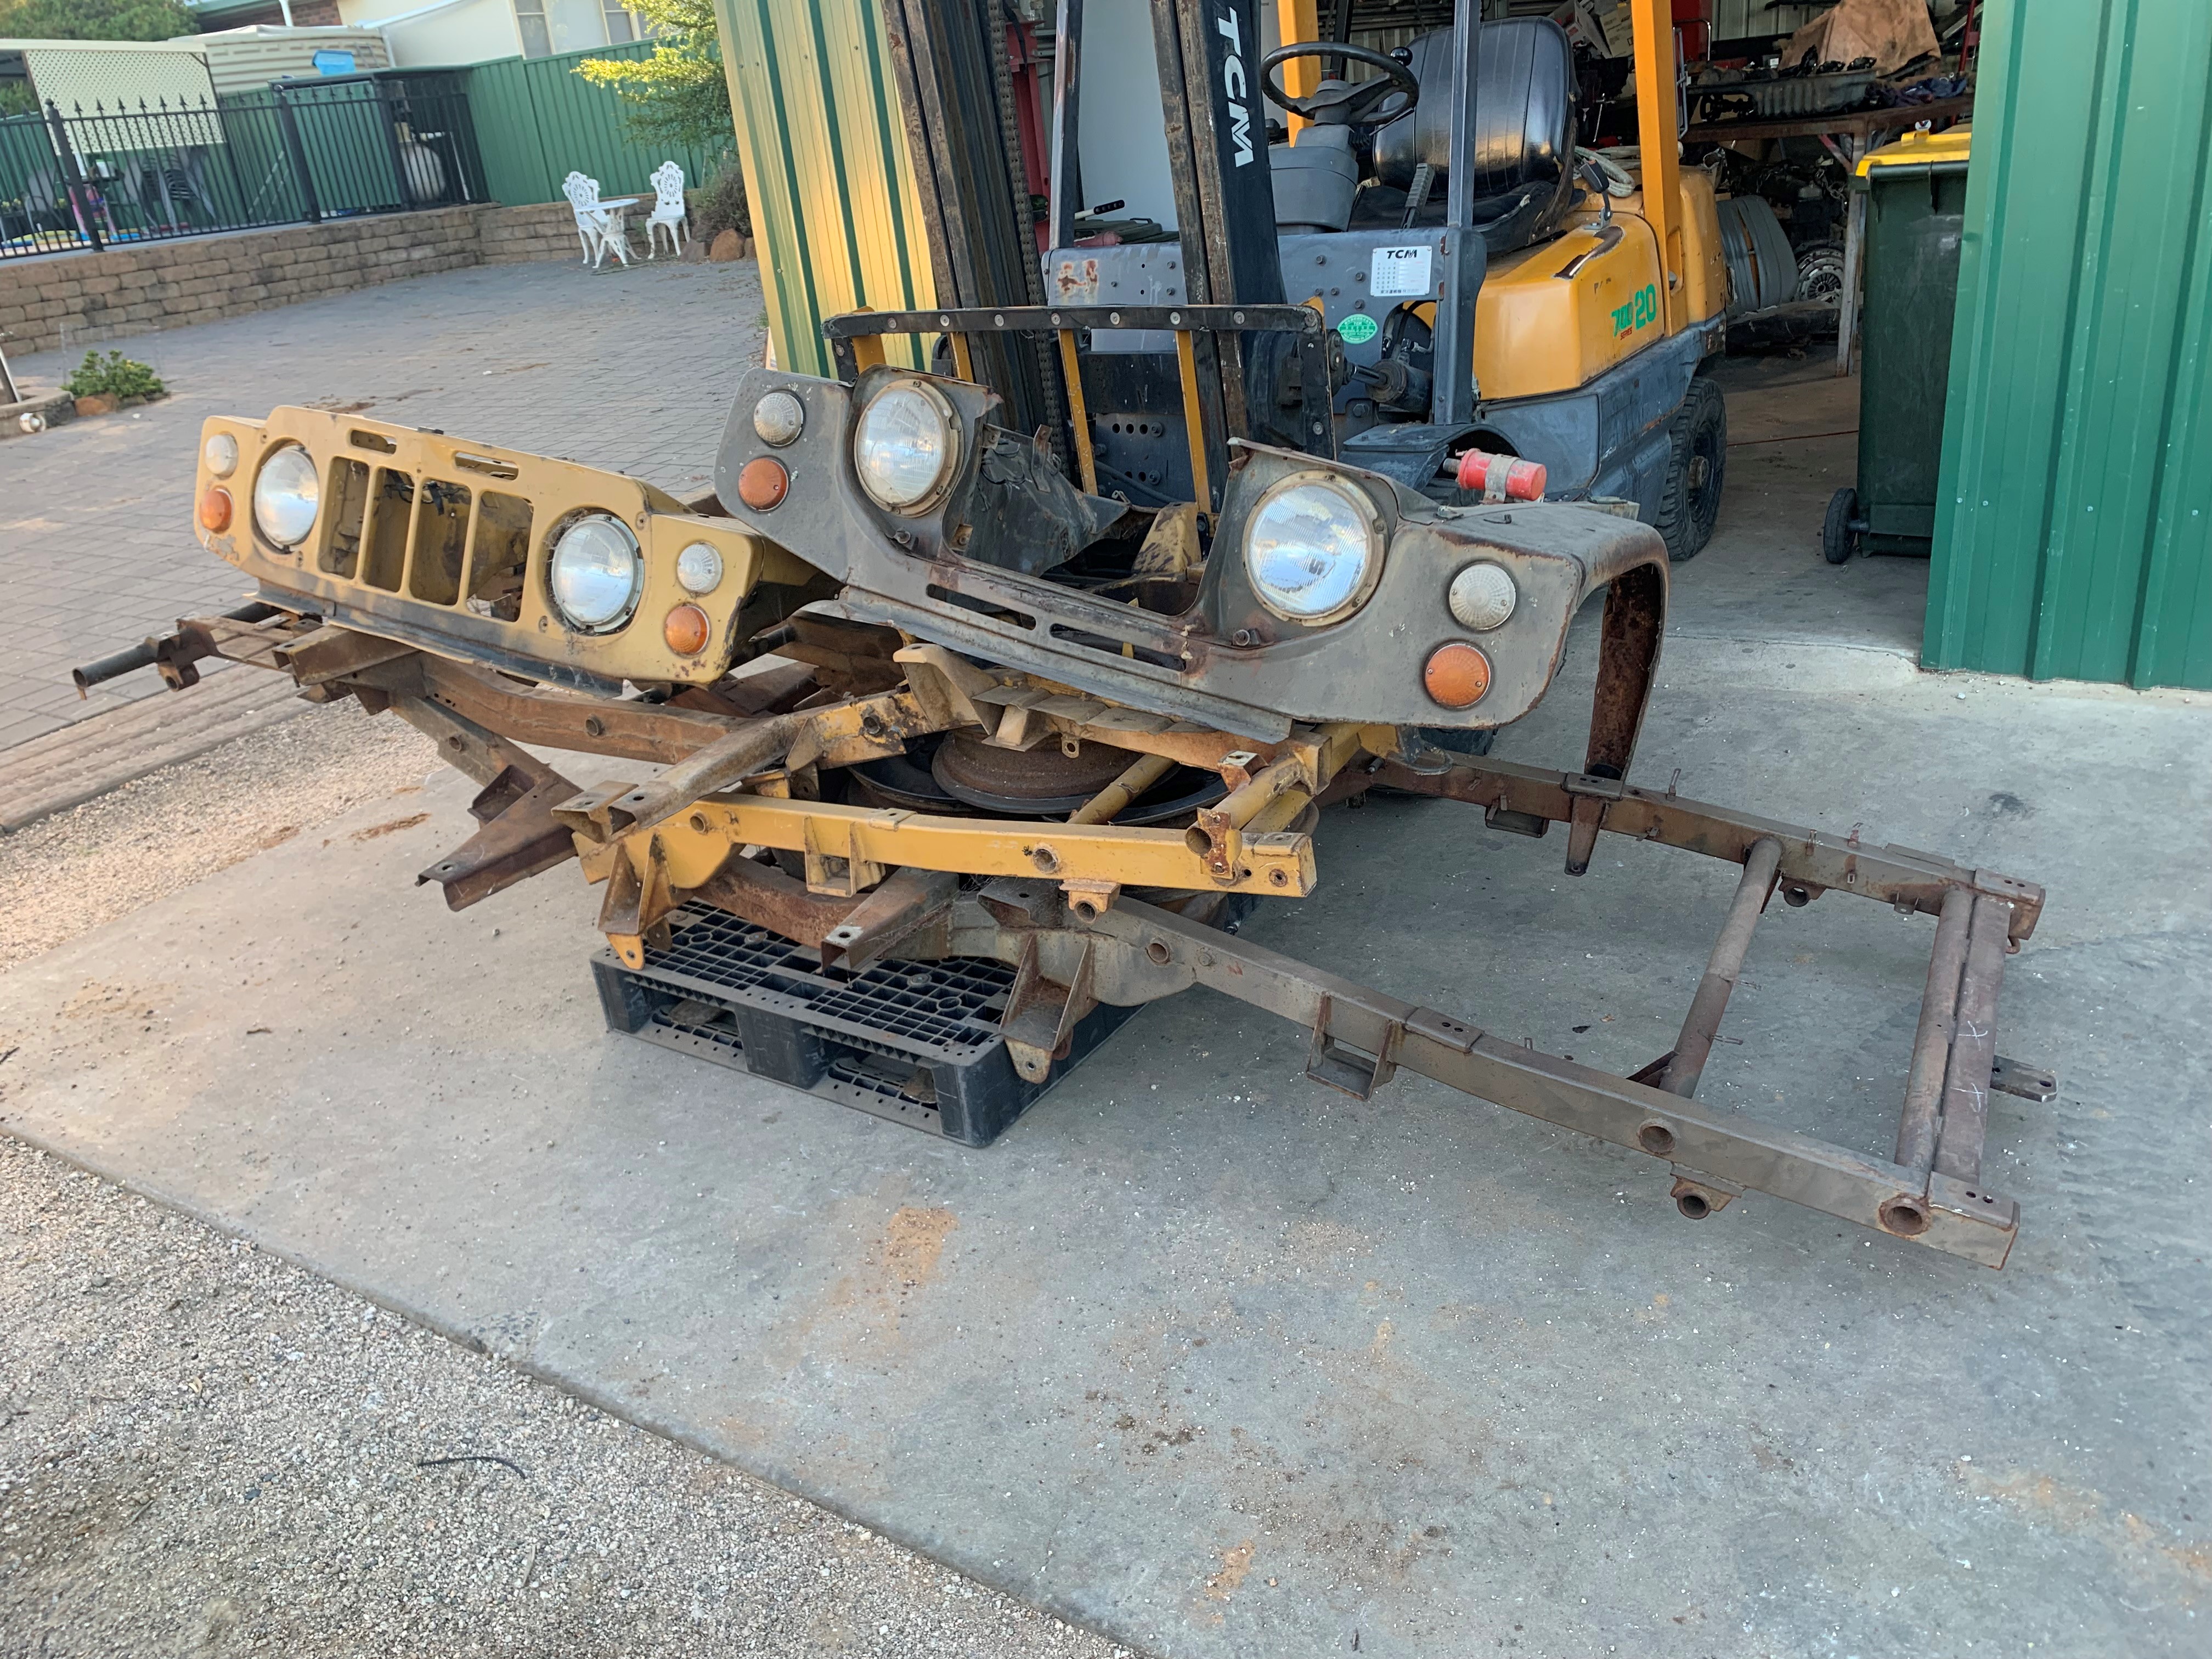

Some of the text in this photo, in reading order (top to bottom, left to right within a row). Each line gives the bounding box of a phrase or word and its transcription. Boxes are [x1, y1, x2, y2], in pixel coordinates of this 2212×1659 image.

[1217, 6, 1254, 167] TCM
[1387, 249, 1417, 259] TCM
[1634, 283, 1656, 330] 20
